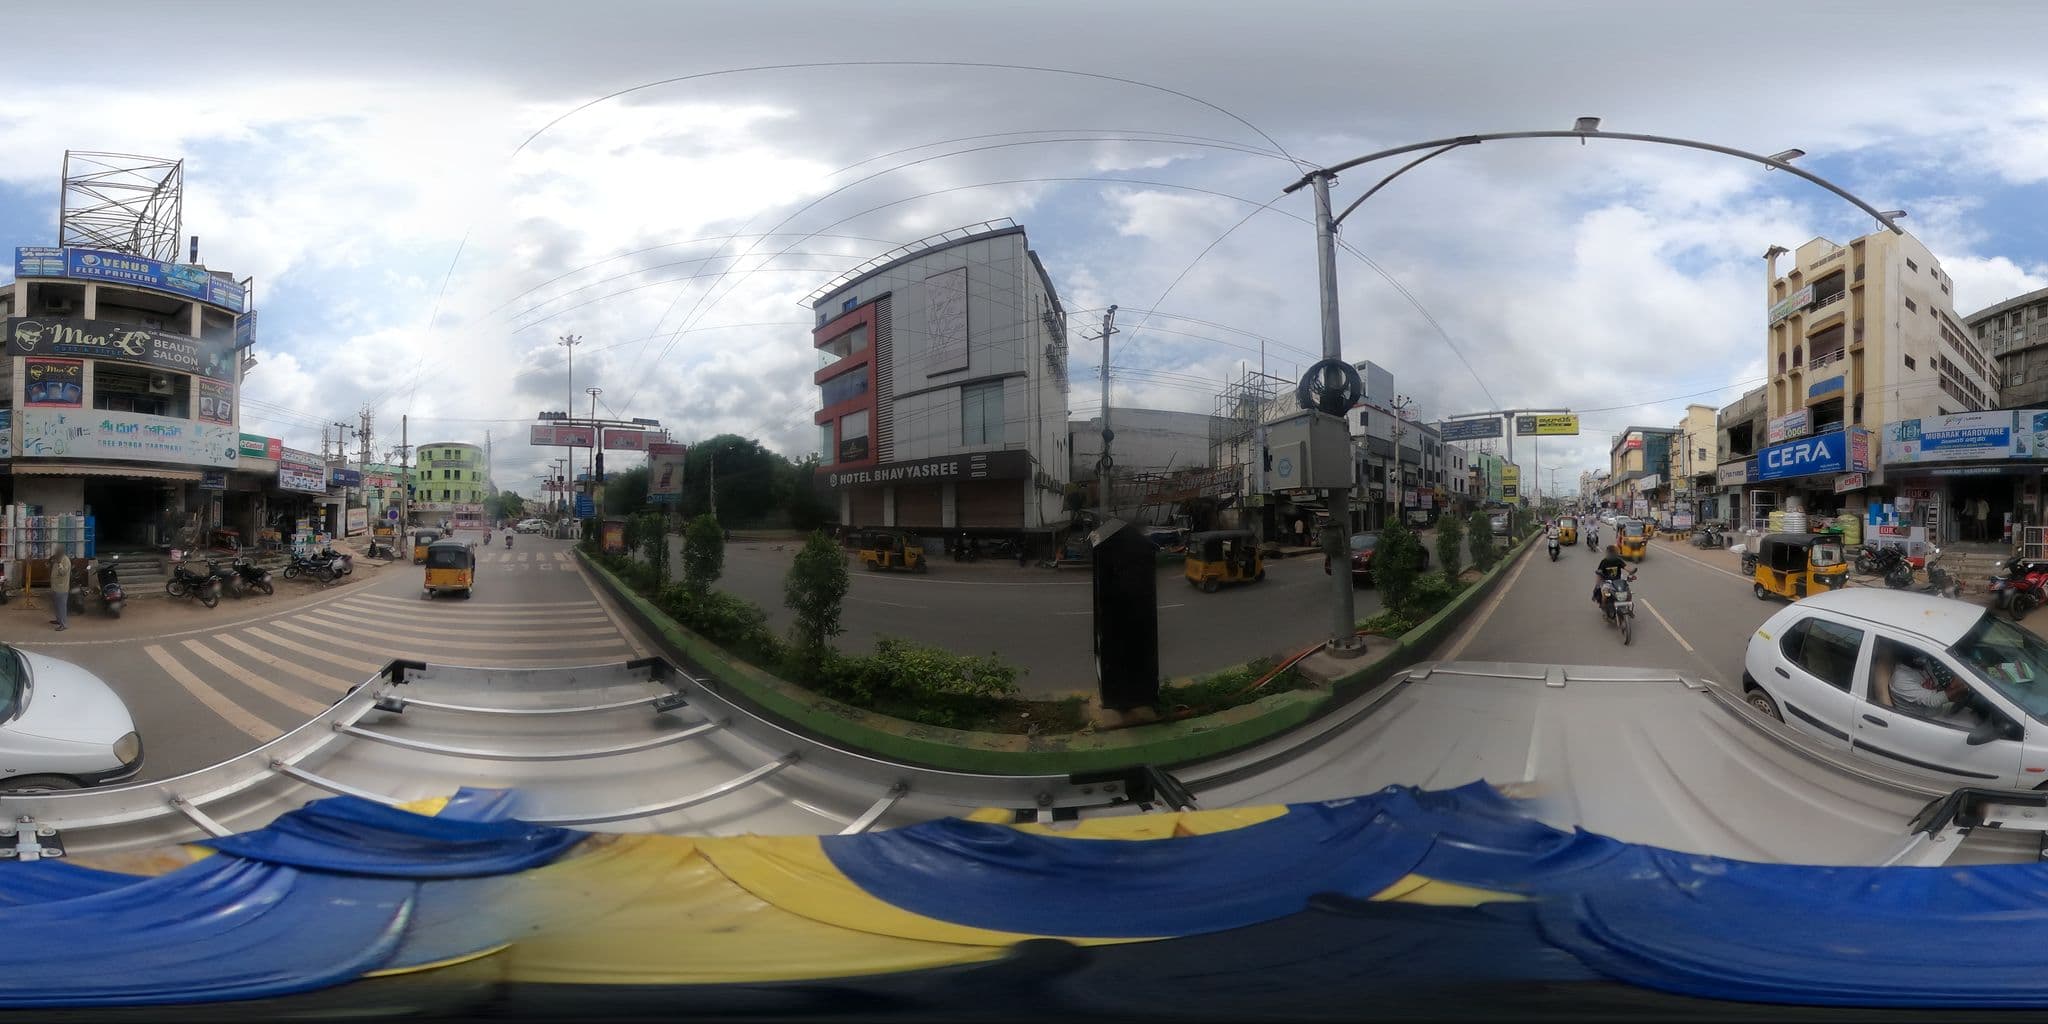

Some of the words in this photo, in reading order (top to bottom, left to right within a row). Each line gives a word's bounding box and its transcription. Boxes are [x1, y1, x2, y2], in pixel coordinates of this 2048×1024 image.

[75, 266, 101, 275] FLEX
[103, 257, 149, 273] VENUS
[154, 339, 199, 355] BEAUTY
[153, 349, 198, 366] SALOON
[1784, 425, 1807, 439] LODGE
[1925, 430, 1960, 440] MUBARAK
[1962, 428, 2004, 438] HARDWARE
[1768, 440, 1831, 468] CERA
[840, 472, 871, 485] HOTEL
[874, 462, 958, 481] BHAVYASREE
